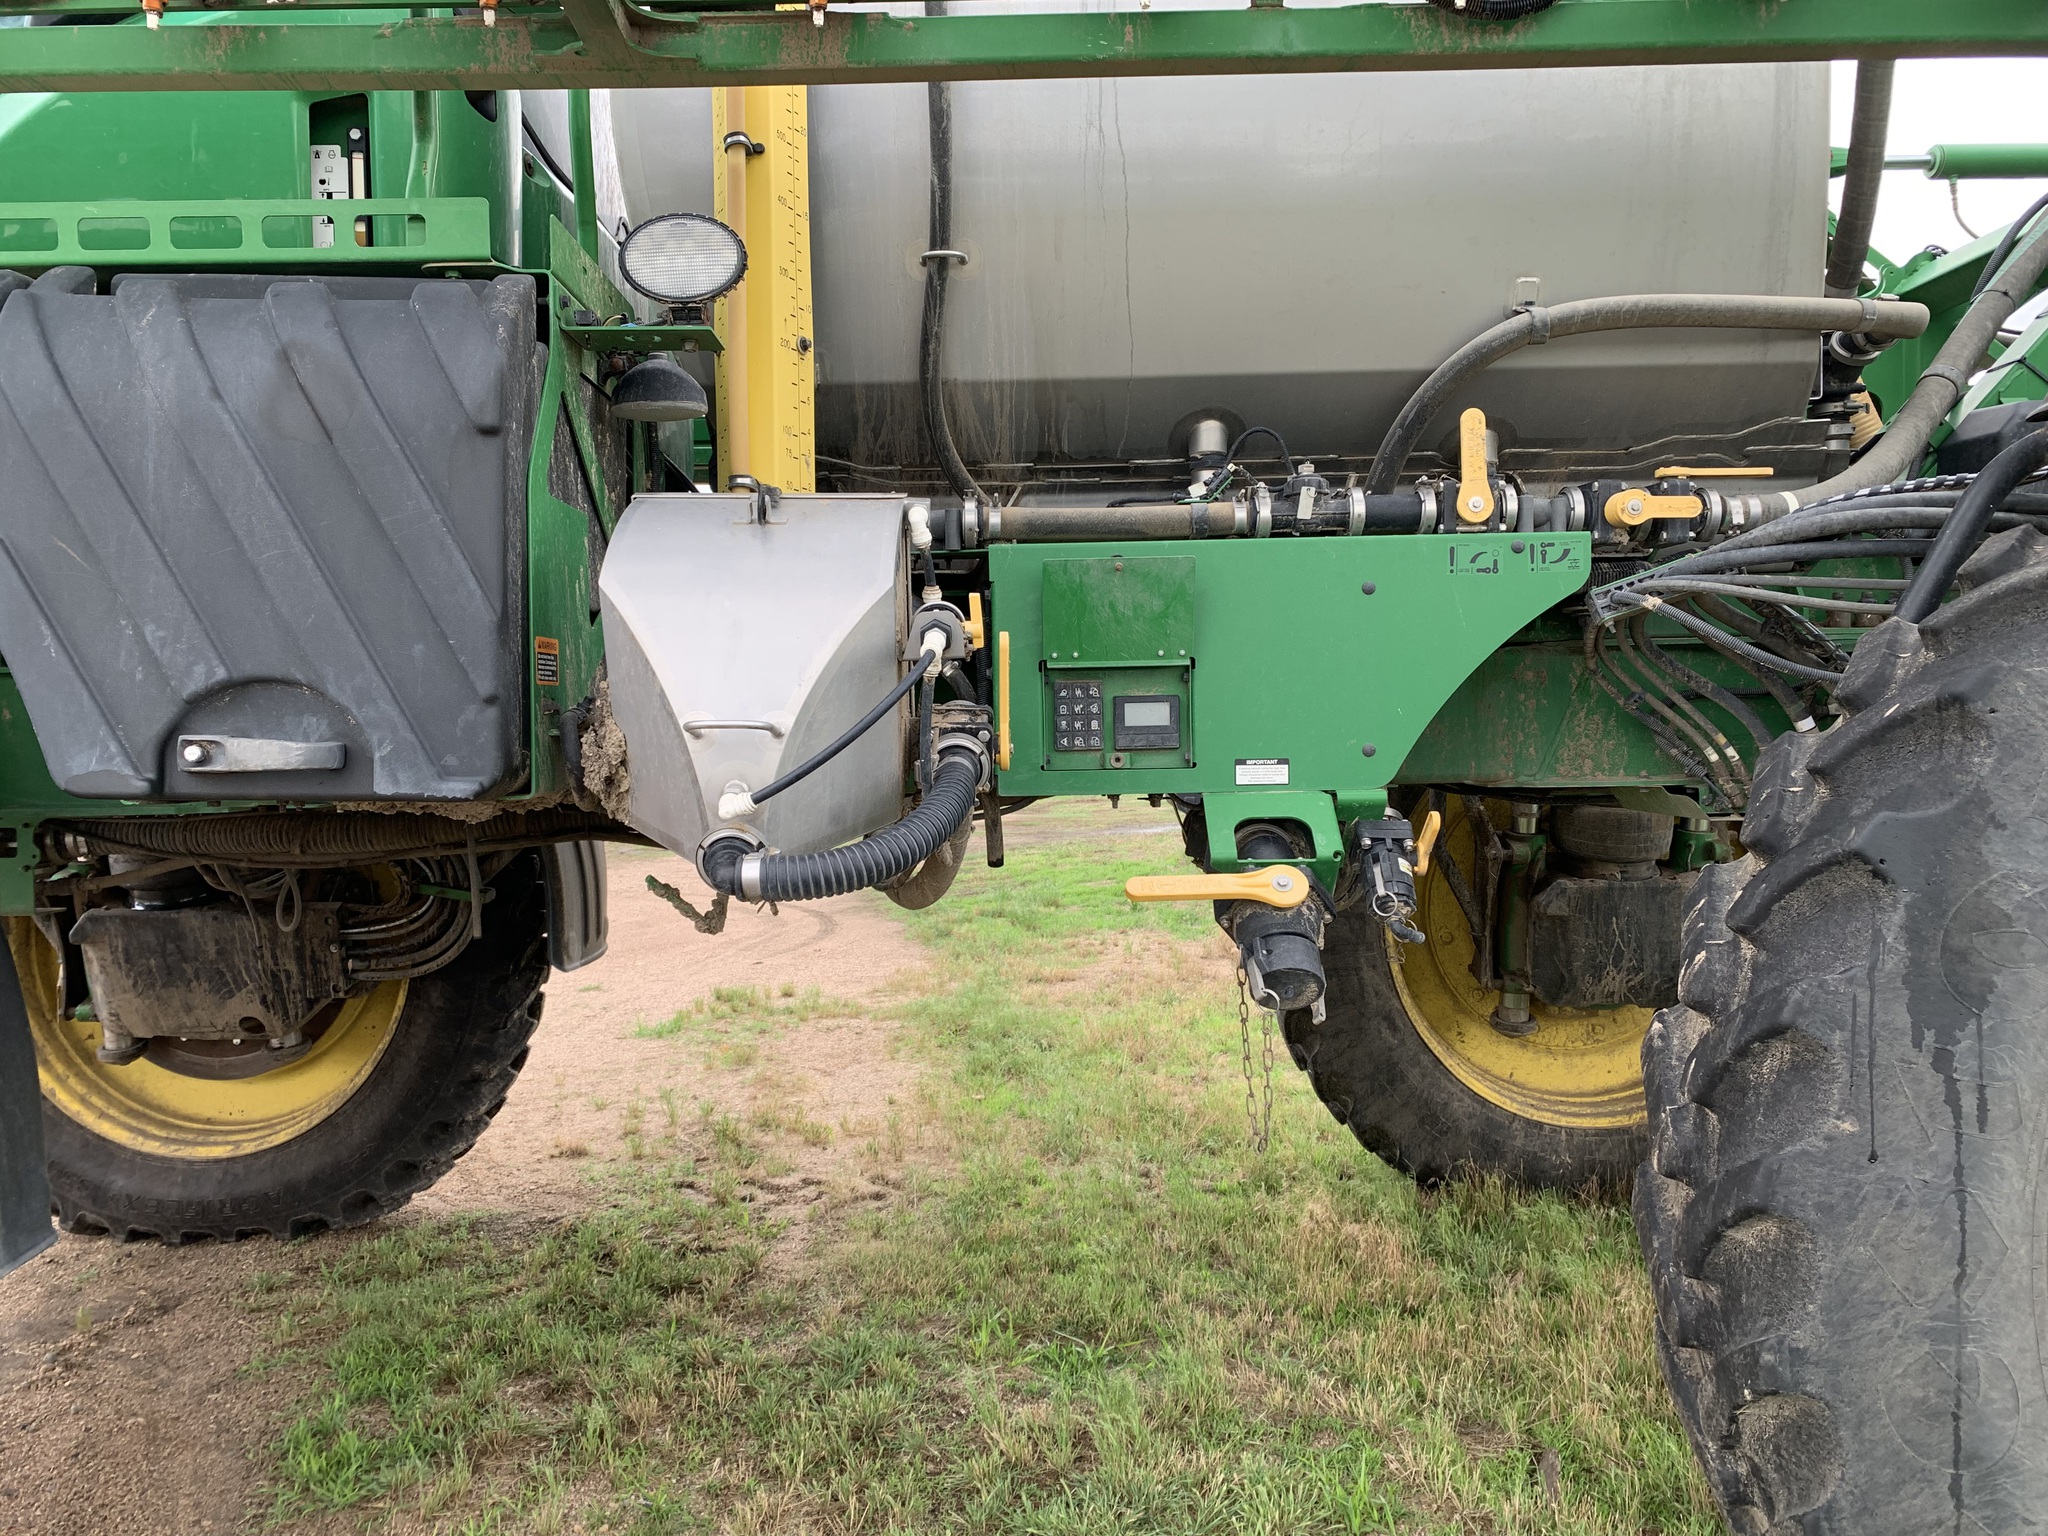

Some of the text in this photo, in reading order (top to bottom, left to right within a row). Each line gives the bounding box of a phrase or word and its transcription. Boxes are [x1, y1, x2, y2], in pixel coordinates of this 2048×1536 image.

[776, 129, 787, 143] 500
[777, 194, 788, 207] 400
[779, 265, 789, 278] 300
[805, 304, 812, 314] 10
[780, 337, 791, 350] 200
[782, 424, 793, 437] 100
[785, 447, 793, 458] 75
[786, 480, 794, 491] 50
